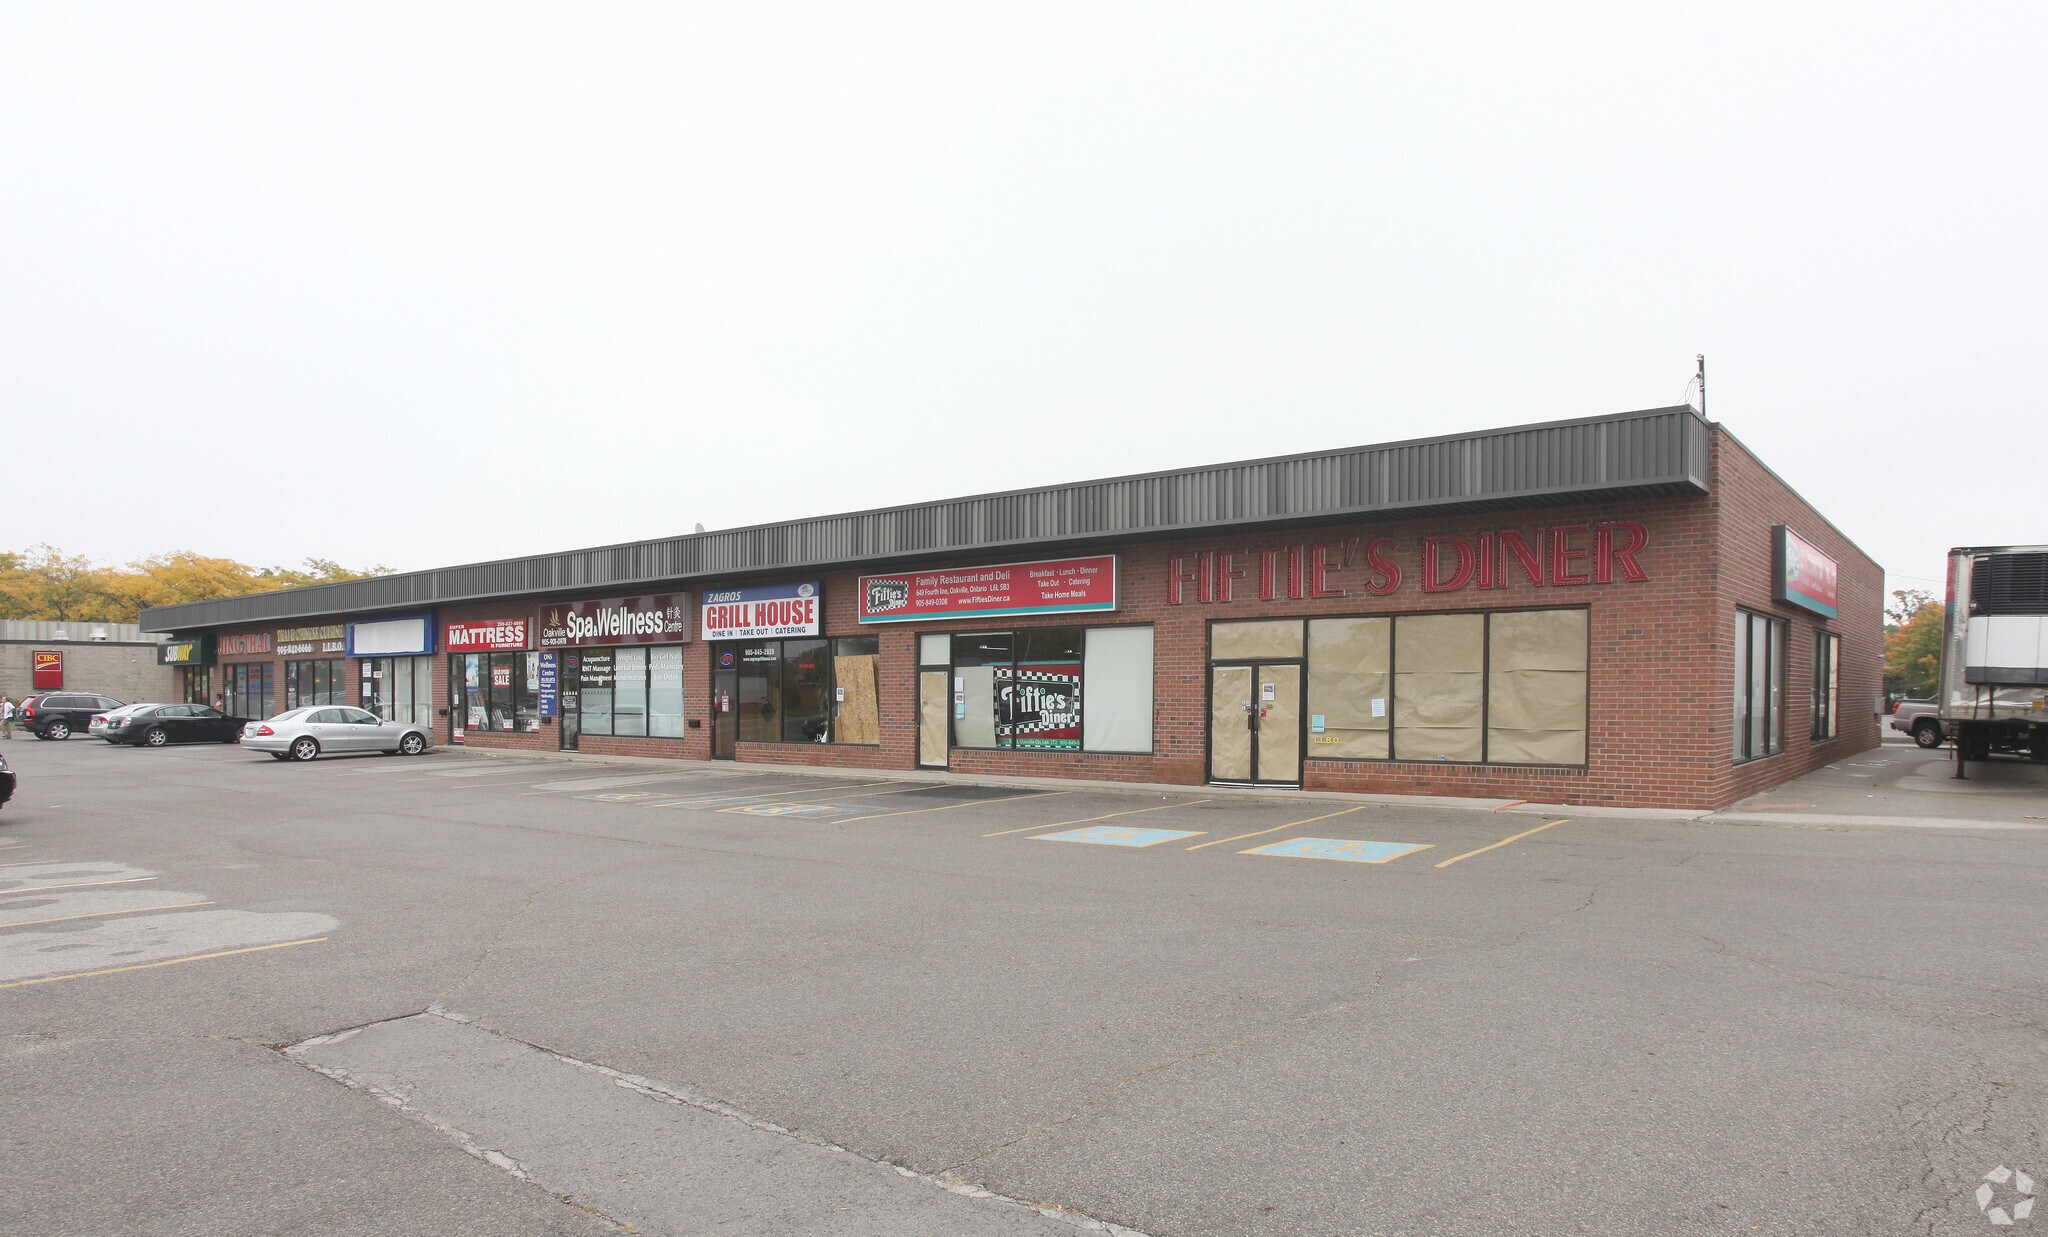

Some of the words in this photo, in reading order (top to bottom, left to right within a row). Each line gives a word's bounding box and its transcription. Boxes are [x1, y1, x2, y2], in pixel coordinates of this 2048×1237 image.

[1167, 536, 1402, 605] FIFTIE'S
[1421, 520, 1650, 594] DINER
[1080, 566, 1098, 574] Dinner
[916, 577, 938, 586] Family
[940, 574, 978, 584] Restaurant
[980, 572, 993, 581] and
[996, 570, 1010, 580] Deli
[708, 591, 741, 603] ZAGROS
[707, 604, 751, 629] GRILL
[755, 600, 813, 627] HOUSE
[449, 626, 524, 645] MATTRESS
[543, 628, 566, 638] Oakville
[664, 620, 682, 632] Centre
[775, 626, 806, 635] CATERING
[37, 654, 59, 662] CIBC
[165, 643, 193, 663] SUBWAY
[583, 656, 611, 664] Acupuncture
[593, 665, 611, 673] Massage
[494, 675, 510, 686] SALE
[1039, 709, 1073, 726] Diner
